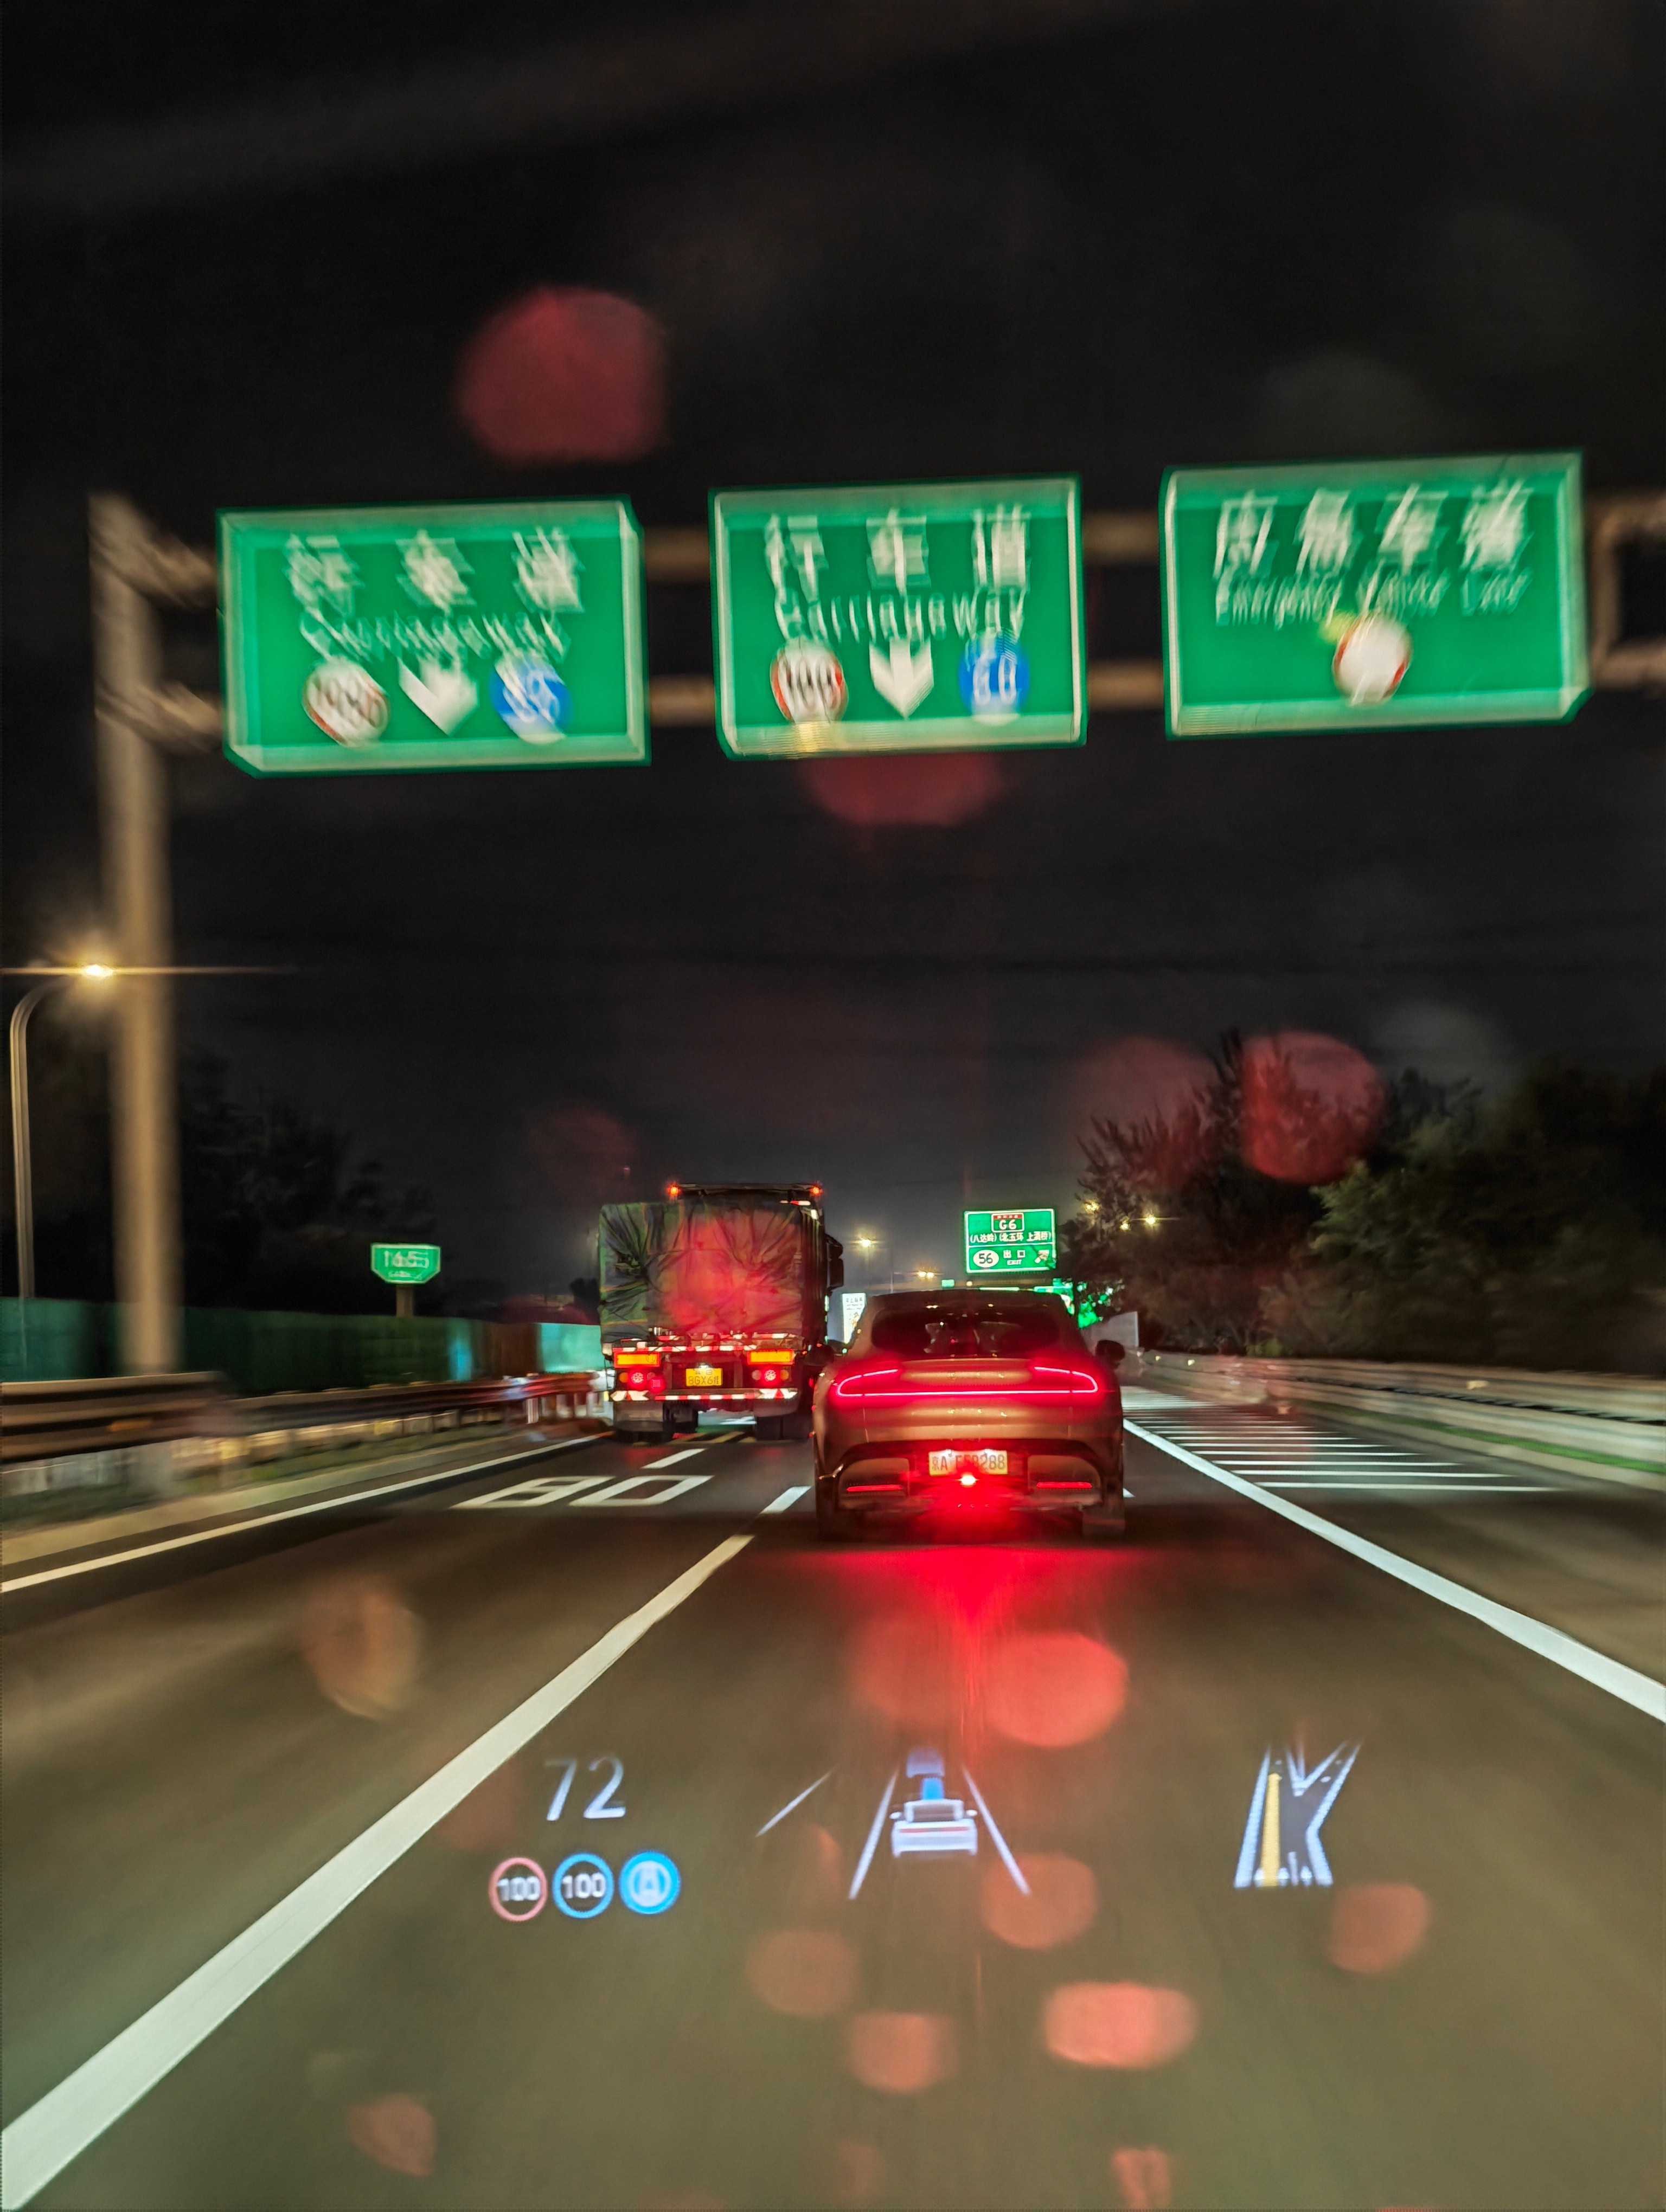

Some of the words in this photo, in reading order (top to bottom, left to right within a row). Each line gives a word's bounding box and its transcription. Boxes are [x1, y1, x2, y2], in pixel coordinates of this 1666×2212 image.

[999, 1219, 1017, 1230] G6
[978, 1253, 994, 1264] 56
[1003, 1250, 1026, 1258] 出口
[545, 1756, 626, 1821] 72
[497, 1876, 541, 1902] 100
[562, 1873, 607, 1899] 100
